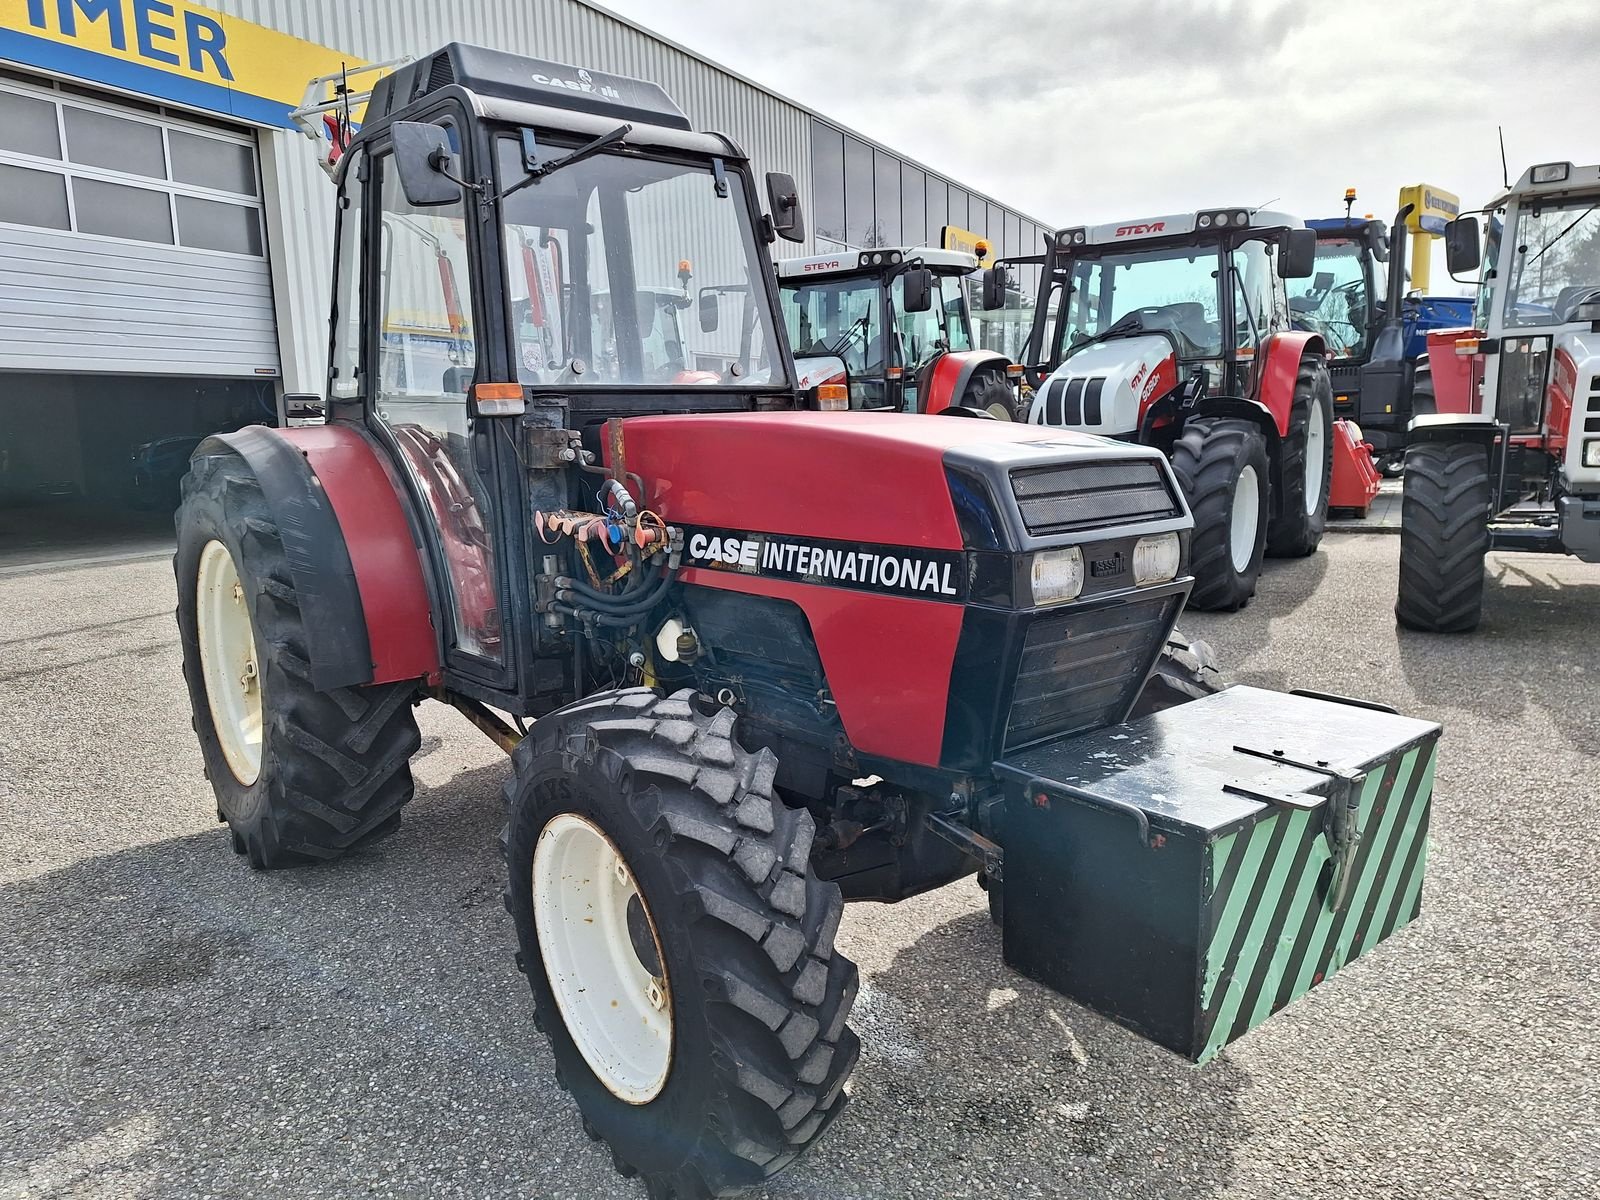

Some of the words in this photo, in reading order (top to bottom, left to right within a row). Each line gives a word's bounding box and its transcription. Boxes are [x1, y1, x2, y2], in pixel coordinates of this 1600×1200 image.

[1115, 222, 1166, 237] STEYR
[804, 260, 840, 272] STEYR
[1415, 329, 1428, 337] NE
[1130, 362, 1147, 390] STEYR
[689, 533, 760, 567] CASE
[762, 541, 957, 595] INTERNATIONAL
